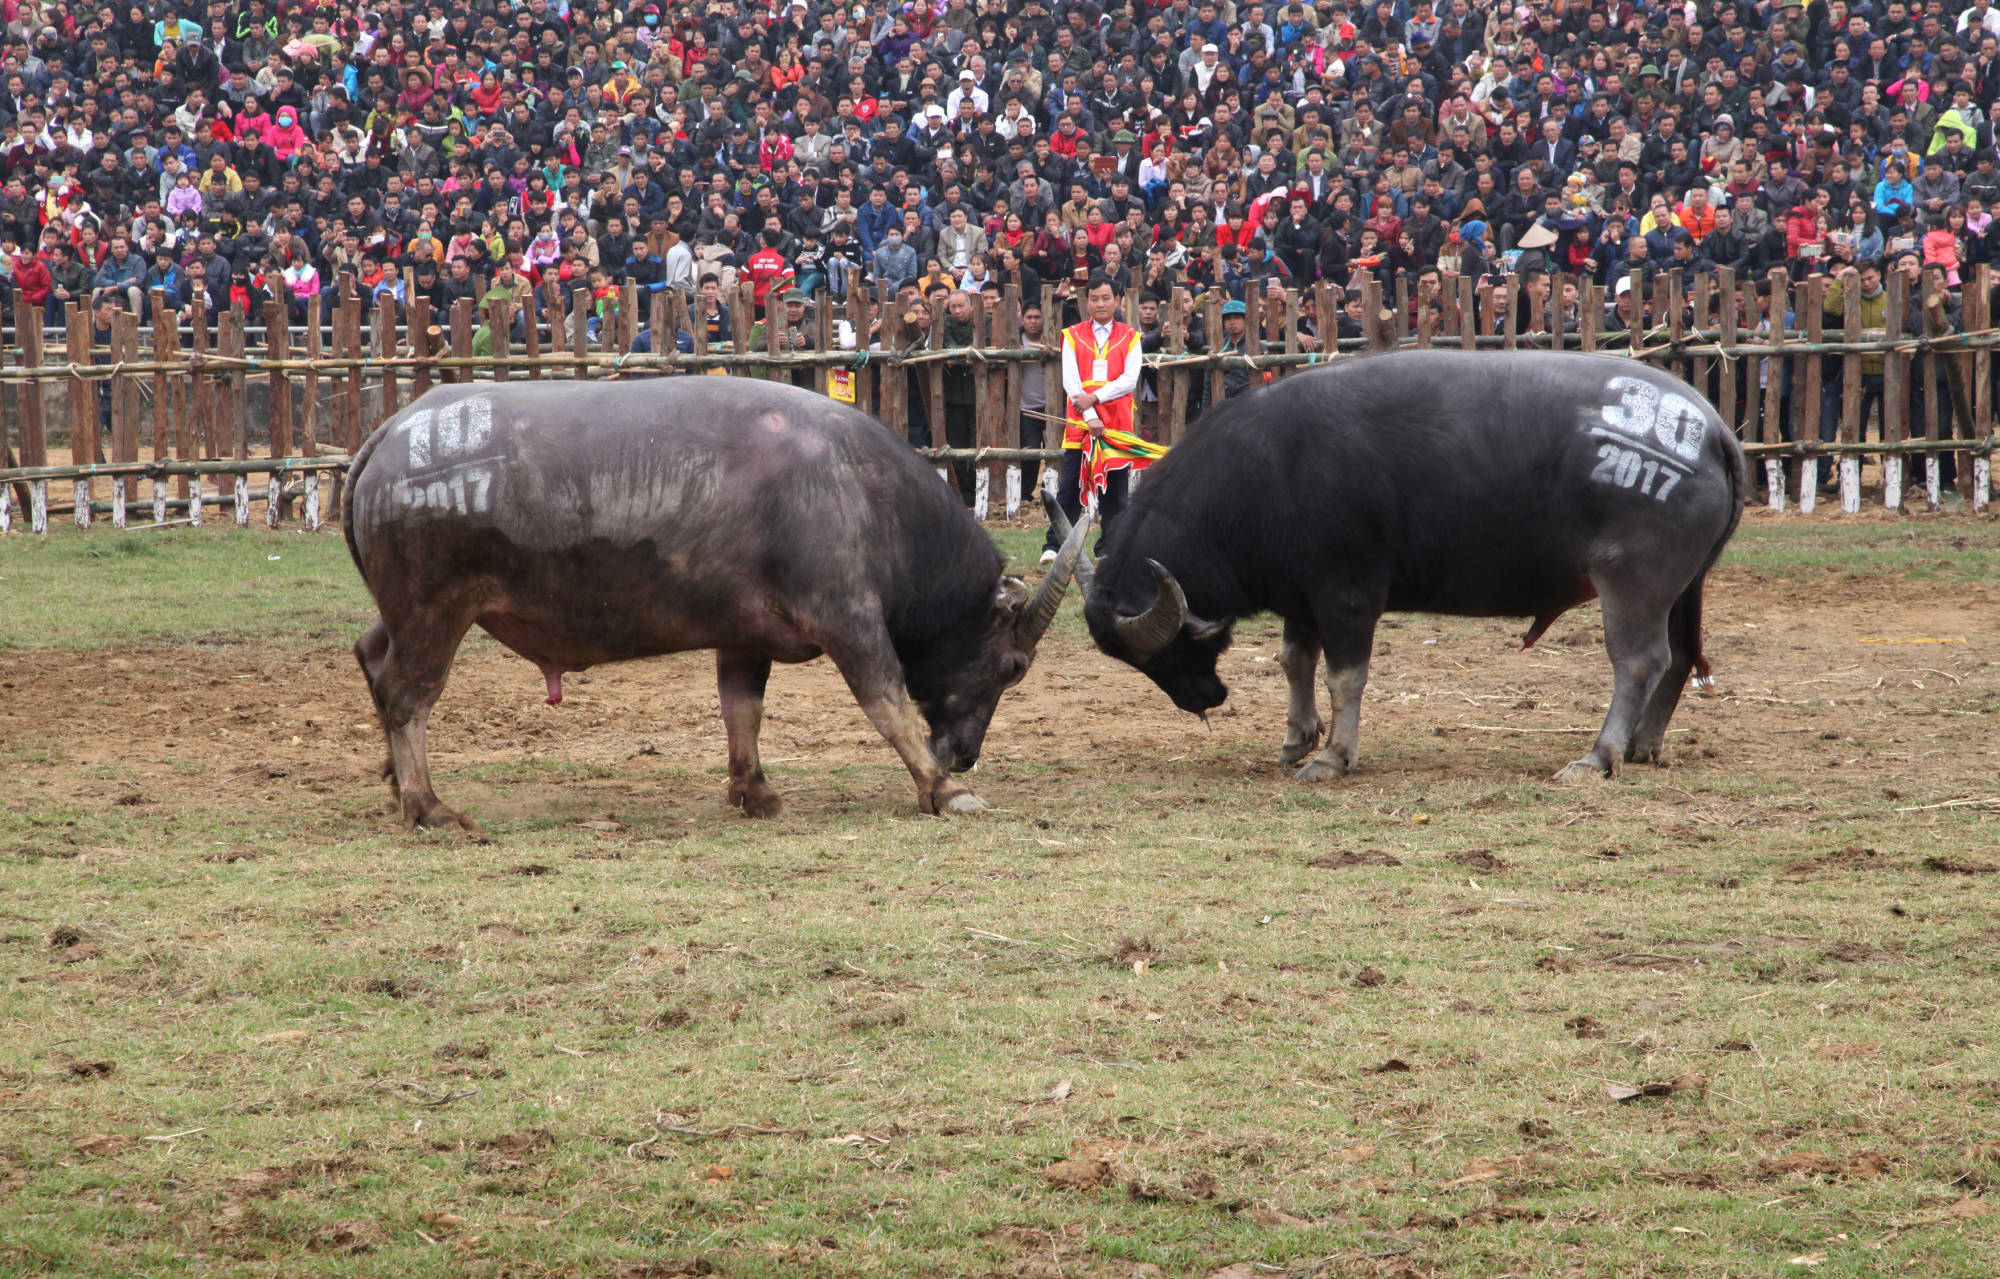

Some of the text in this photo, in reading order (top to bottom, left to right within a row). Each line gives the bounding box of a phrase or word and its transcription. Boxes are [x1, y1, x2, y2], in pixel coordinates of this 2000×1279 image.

[396, 398, 492, 469] 10
[1601, 376, 1708, 460] 30
[1590, 444, 1681, 502] 2017
